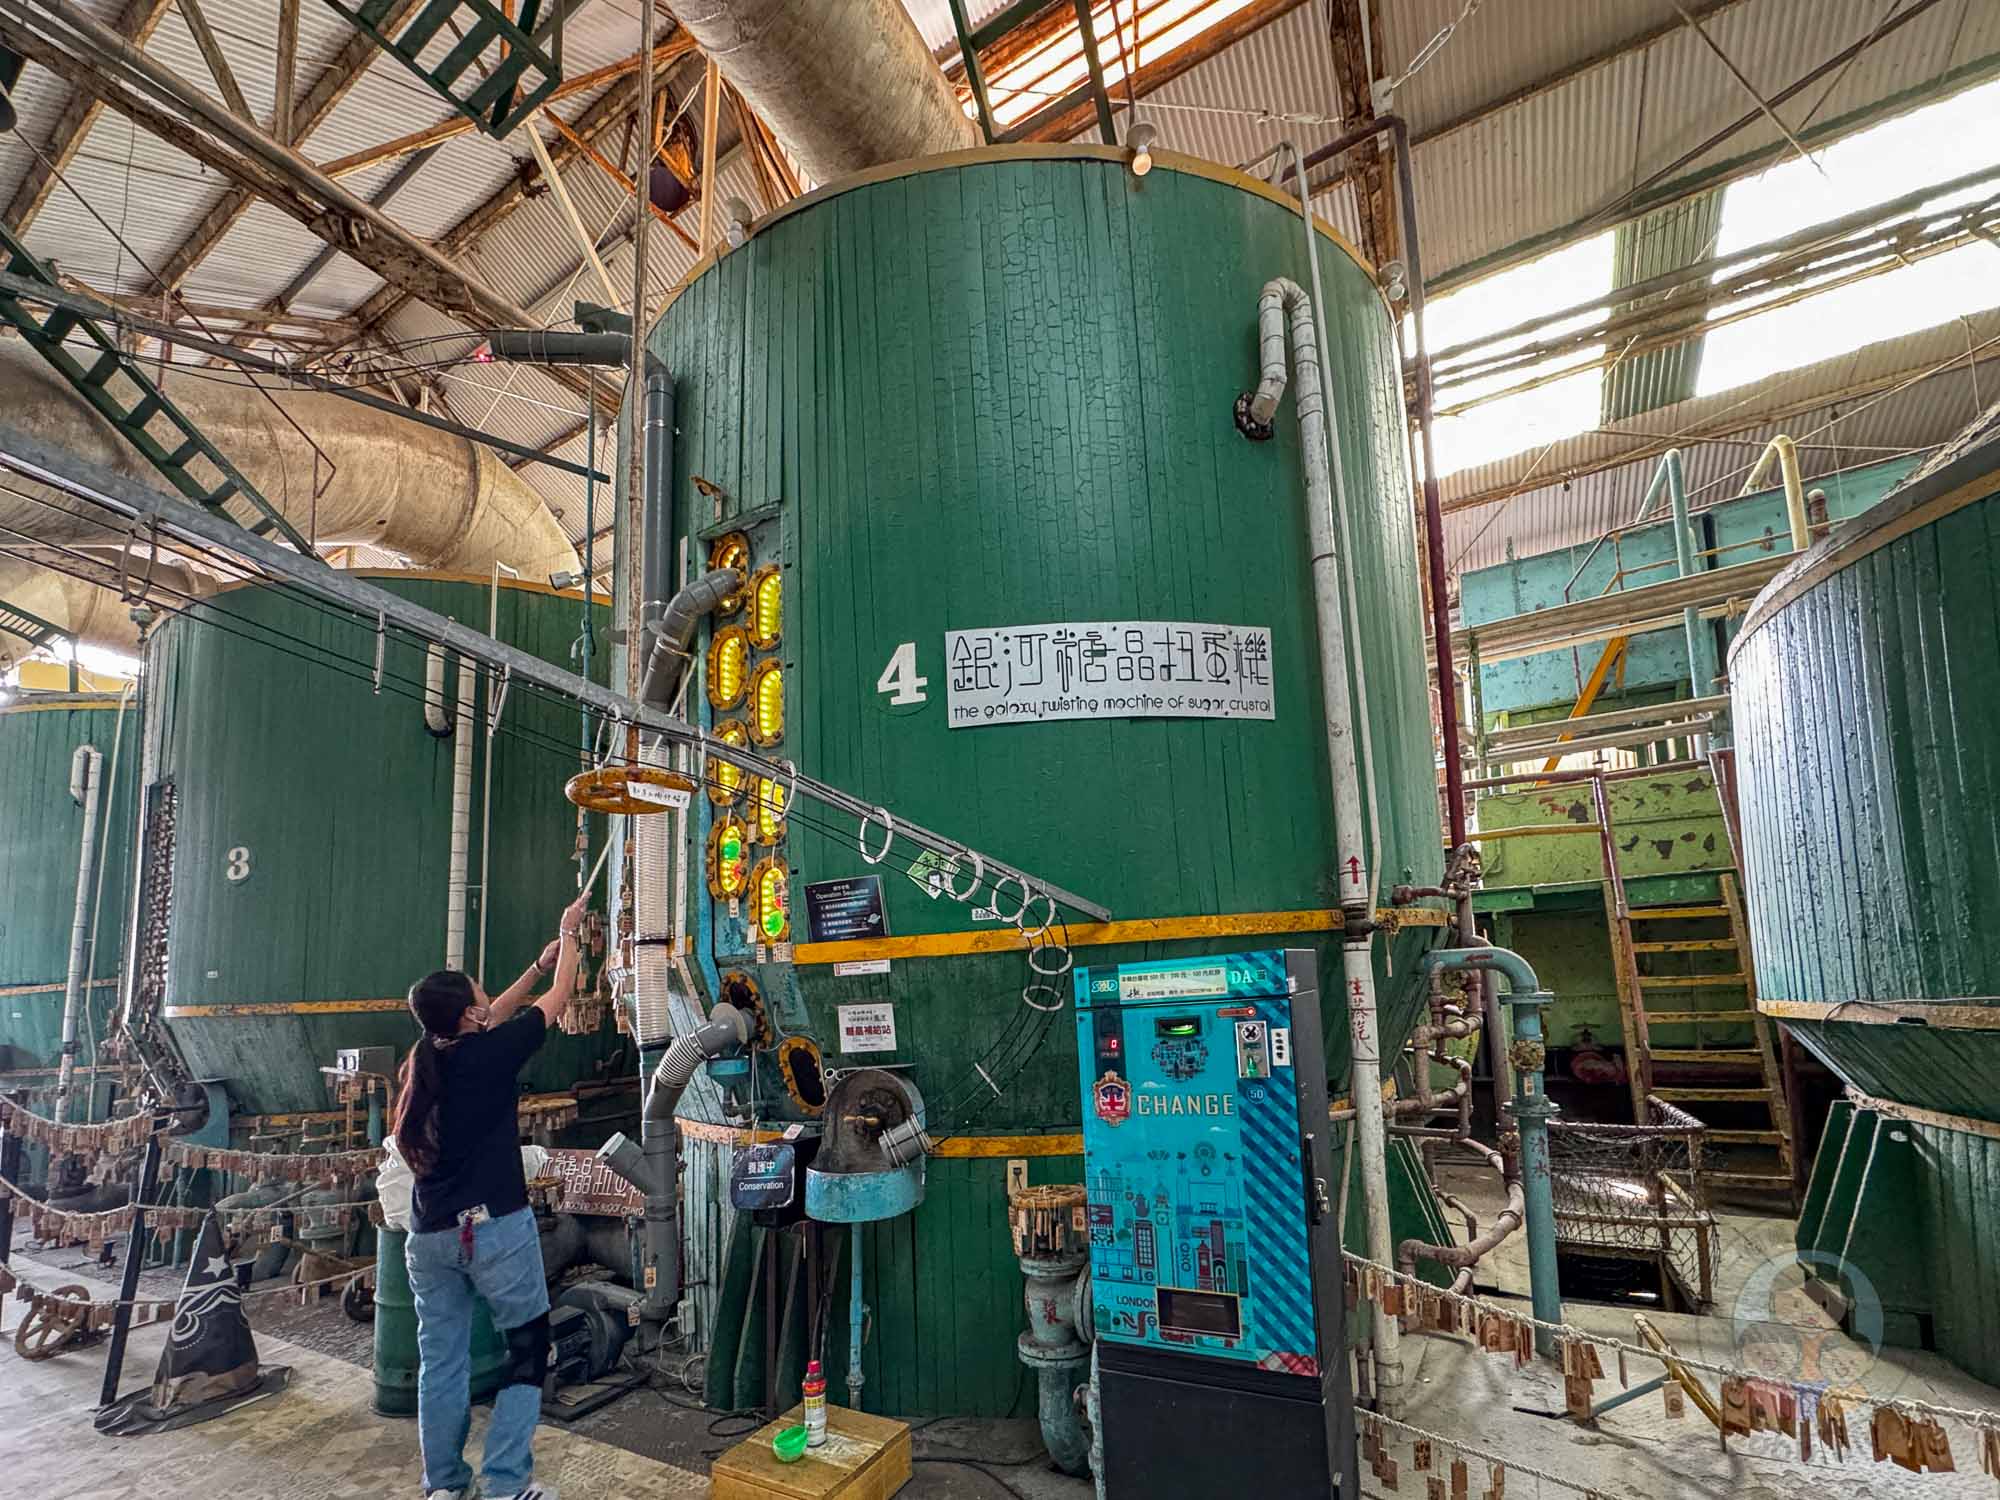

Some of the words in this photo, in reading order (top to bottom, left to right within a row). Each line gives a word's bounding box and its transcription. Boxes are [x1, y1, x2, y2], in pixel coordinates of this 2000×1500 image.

[877, 642, 928, 705] 4
[954, 705, 979, 720] the
[984, 700, 1037, 719] galaxy
[1042, 696, 1099, 713] twisting
[1104, 694, 1164, 712] machine
[1168, 695, 1184, 709] of
[1188, 699, 1225, 712] sugar
[1229, 699, 1271, 713] crystal
[227, 846, 250, 881] 3
[1137, 1094, 1234, 1115] CHANGE
[1250, 1089, 1264, 1099] 50
[738, 1182, 784, 1192] Conservation
[1116, 1295, 1157, 1308] LONDON
